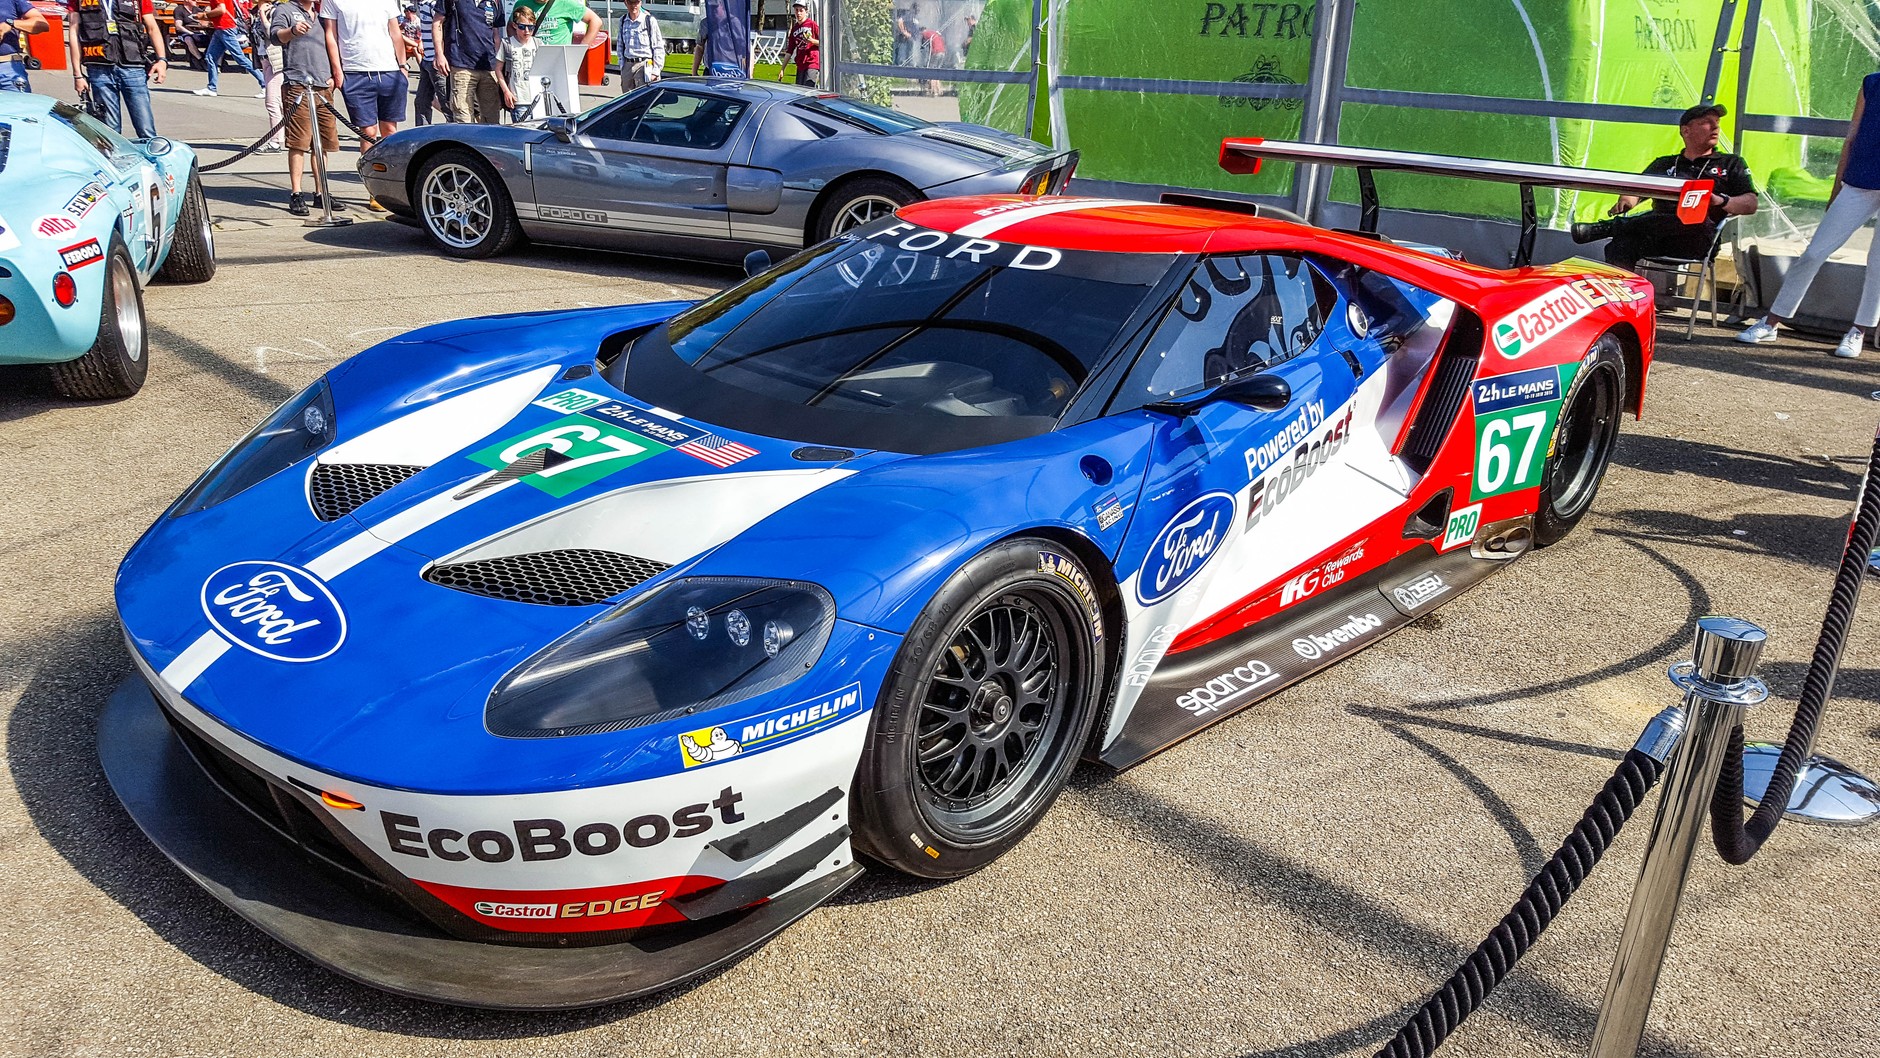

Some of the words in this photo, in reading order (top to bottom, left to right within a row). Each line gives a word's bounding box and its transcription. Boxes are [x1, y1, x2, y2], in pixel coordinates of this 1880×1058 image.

[540, 207, 583, 220] FORD
[584, 211, 606, 222] GT
[1681, 189, 1710, 209] GT
[38, 218, 77, 236] TRICO
[866, 222, 1062, 271] FORD
[62, 243, 101, 266] FERODO
[1517, 289, 1585, 344] Castrol
[1570, 278, 1647, 309] EDGE
[542, 391, 600, 411] PRO
[1501, 386, 1517, 399] LE
[1518, 379, 1554, 396] MANS
[499, 424, 649, 478] 67
[623, 416, 649, 426] LE
[640, 422, 690, 440] MANS
[1243, 406, 1310, 480] Powered
[1308, 398, 1325, 431] by
[1476, 410, 1547, 494] 67
[1244, 403, 1353, 535] EcoBoost
[1155, 509, 1220, 592] Ford
[1445, 510, 1478, 544] PRO
[1057, 558, 1103, 638] MICHELIN
[1279, 568, 1320, 608] IHG
[1323, 546, 1365, 574] Rewards
[1321, 568, 1345, 588] Club
[214, 571, 322, 645] Ford
[1309, 613, 1383, 652] brembo
[1176, 659, 1272, 712] sparco
[741, 690, 858, 743] MICHELIN
[379, 786, 746, 863] EcoBoost
[495, 903, 552, 918] Castrol
[560, 889, 667, 919] EDGE
